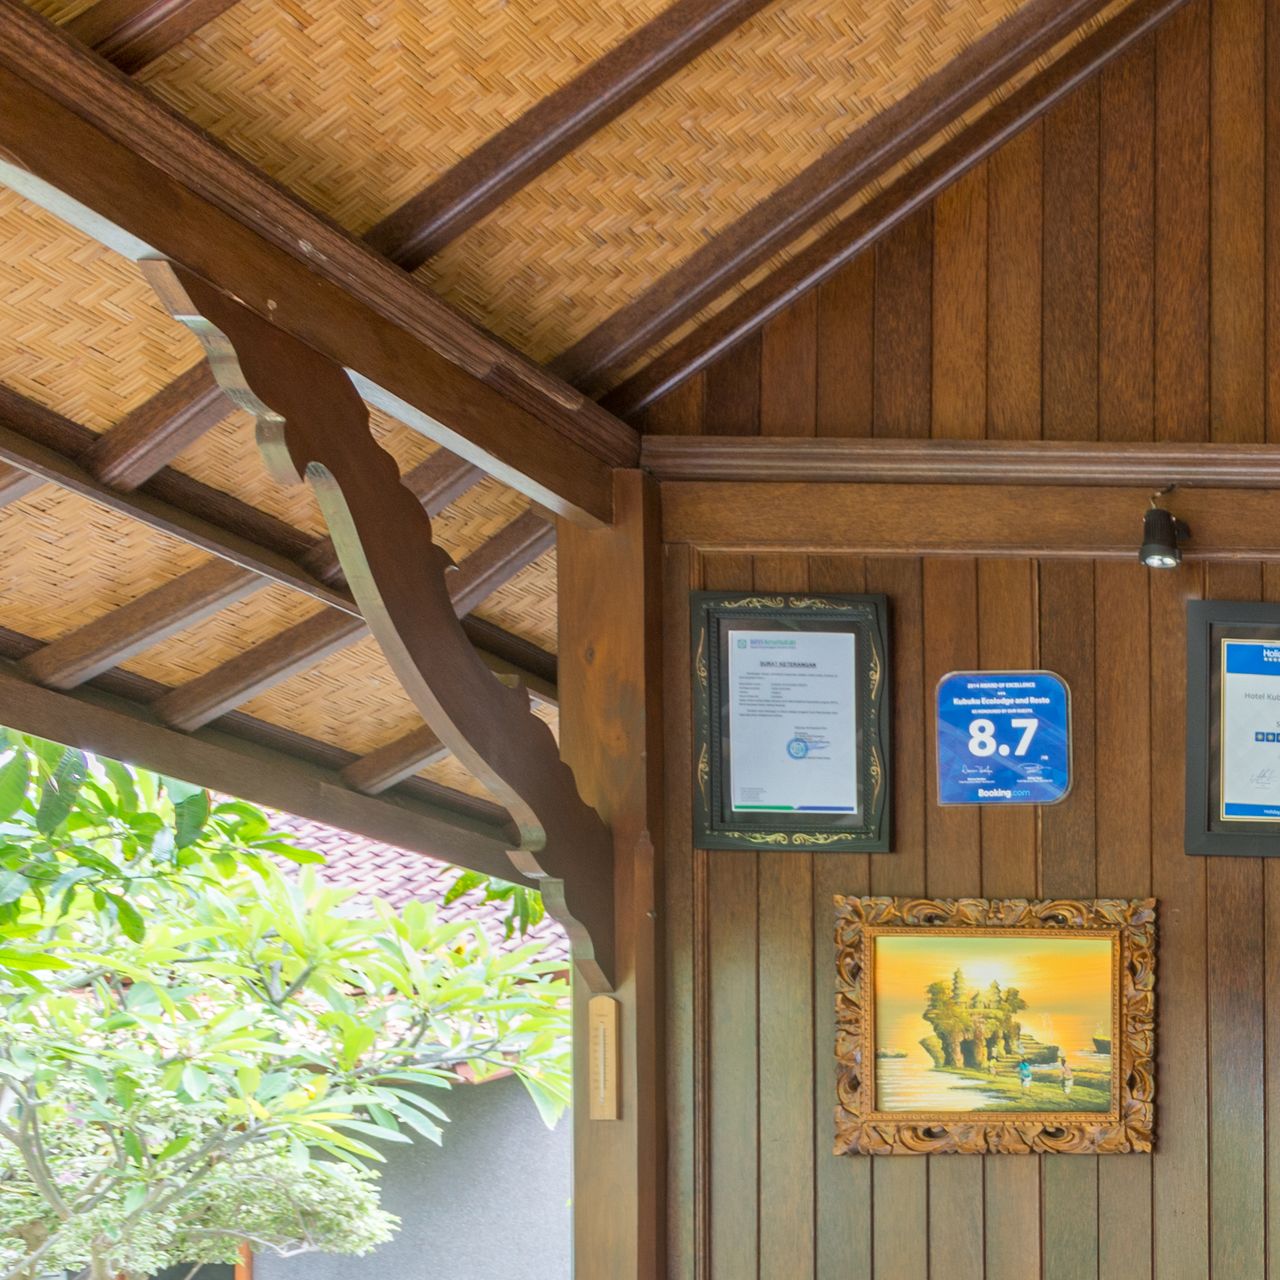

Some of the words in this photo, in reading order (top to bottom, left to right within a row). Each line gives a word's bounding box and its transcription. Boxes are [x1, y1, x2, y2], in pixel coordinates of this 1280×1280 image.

[1244, 692, 1265, 700] Hotel
[981, 697, 1014, 705] Ecolodge
[968, 718, 1039, 757] 8.7
[978, 789, 1031, 798] Booking.com
